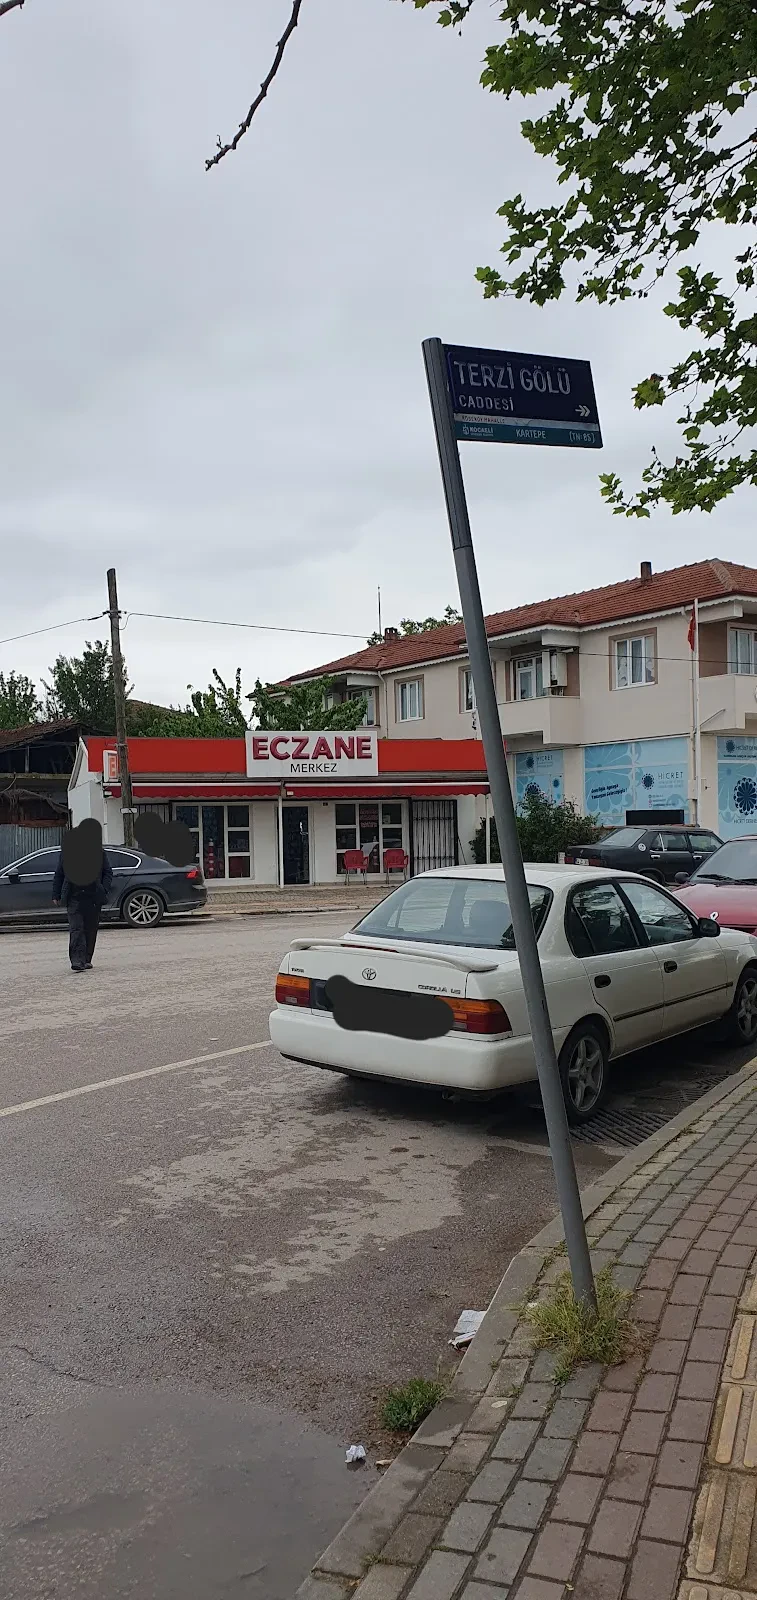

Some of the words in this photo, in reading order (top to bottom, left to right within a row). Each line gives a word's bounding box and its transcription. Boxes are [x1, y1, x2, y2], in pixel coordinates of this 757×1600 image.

[453, 361, 515, 389] TERZİ
[519, 365, 571, 395] GÖLÜ
[459, 394, 514, 411] CADDESİ
[516, 429, 547, 439] KARTEPE
[252, 736, 373, 760] ECZANE
[290, 763, 338, 773] MERKEZ
